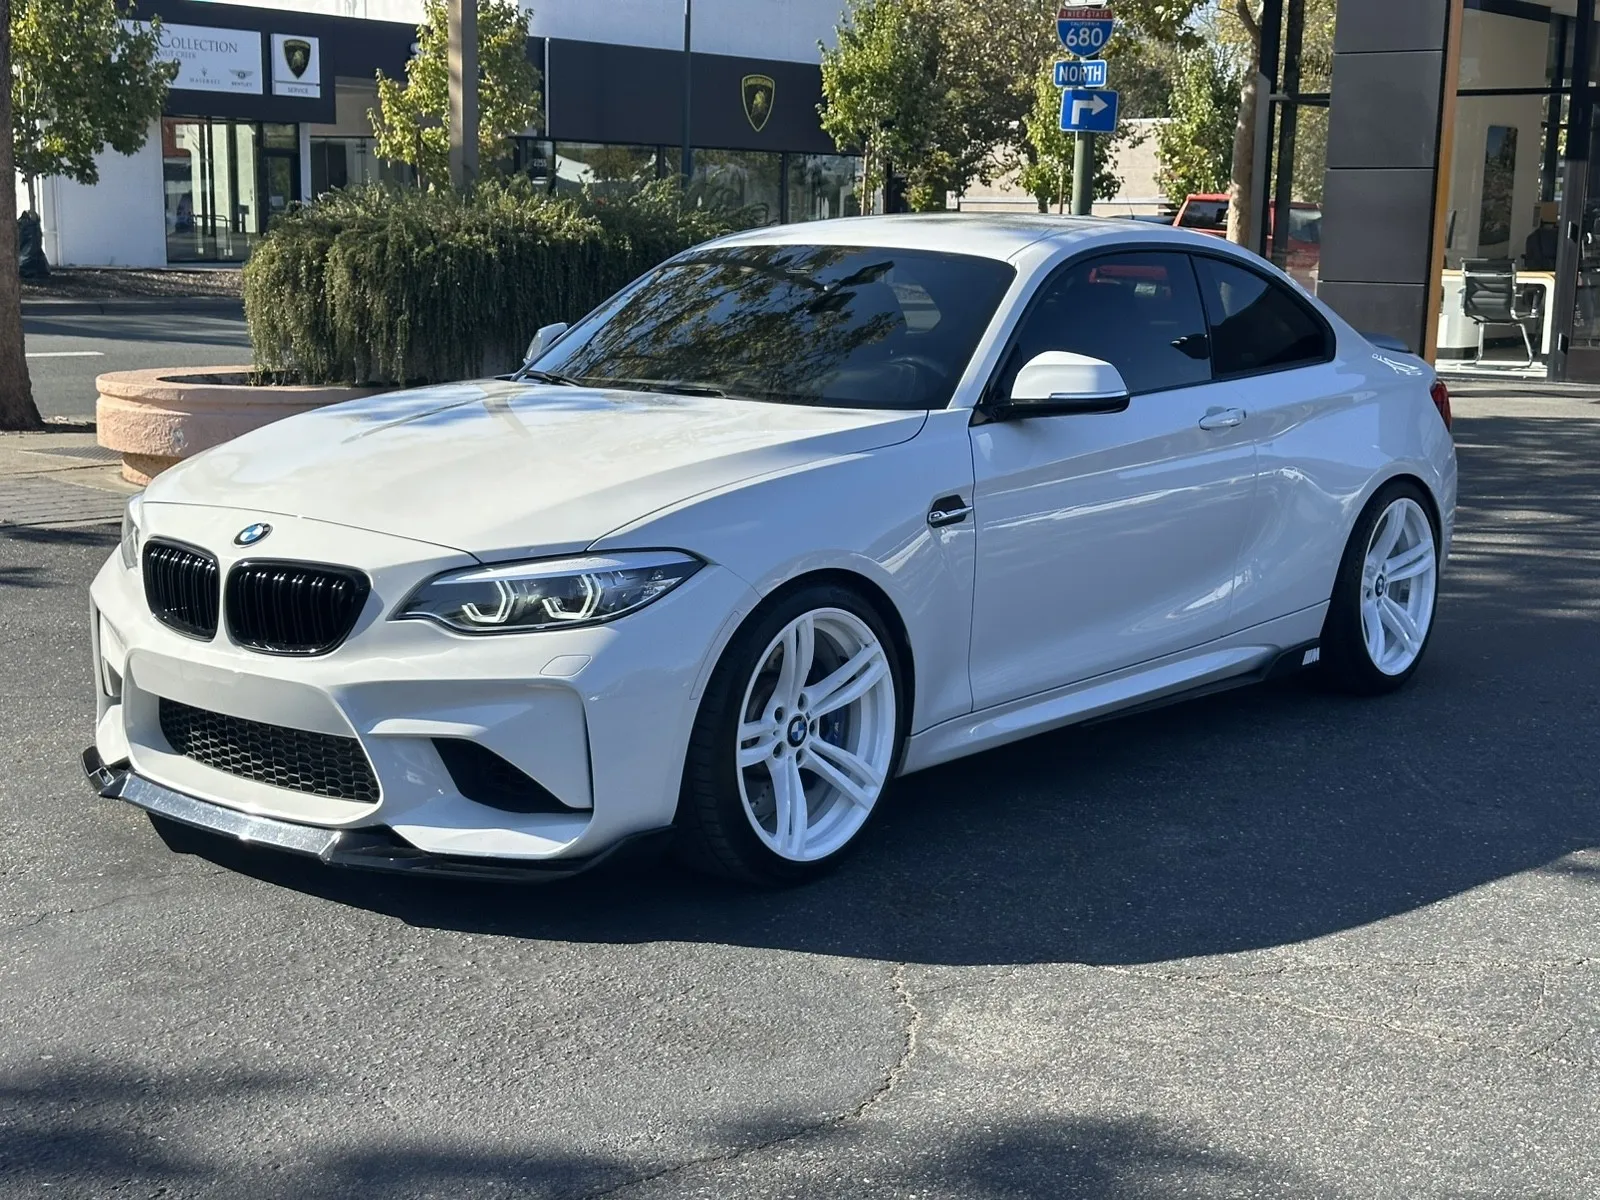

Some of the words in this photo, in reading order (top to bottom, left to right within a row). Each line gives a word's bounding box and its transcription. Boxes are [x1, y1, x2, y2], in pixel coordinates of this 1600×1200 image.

[1063, 10, 1109, 18] INTERSTATE
[1066, 28, 1103, 47] 680
[1059, 65, 1102, 82] NORTH
[287, 86, 309, 94] SERVICE
